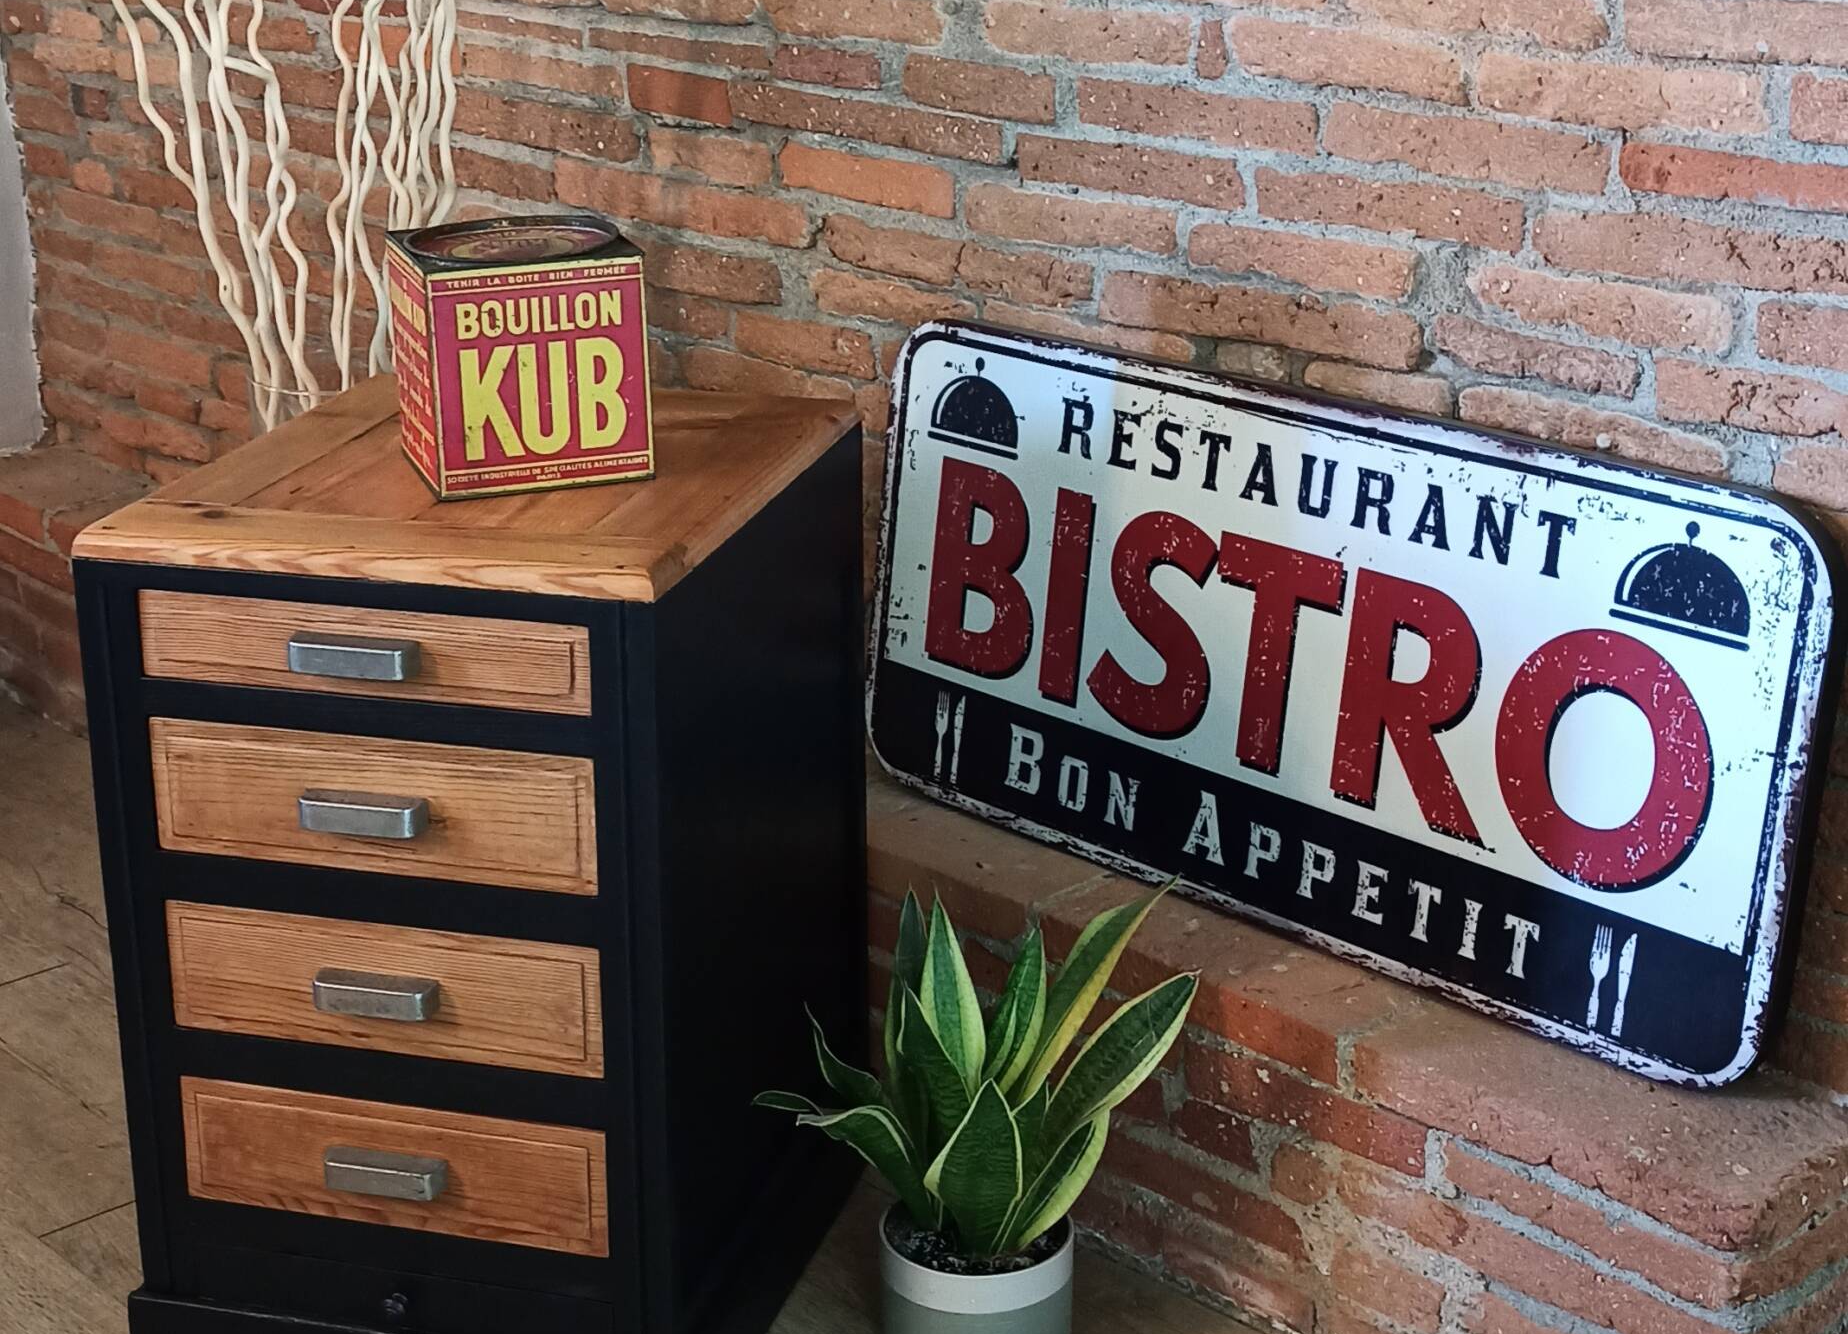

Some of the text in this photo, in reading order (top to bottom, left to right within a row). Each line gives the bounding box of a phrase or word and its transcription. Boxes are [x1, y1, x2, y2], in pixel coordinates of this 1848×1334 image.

[446, 280, 481, 289] TENIR
[487, 277, 501, 286] LA
[549, 271, 574, 281] BIEN
[455, 289, 622, 340] BOUILLON
[459, 336, 628, 462] KUB
[1057, 393, 1578, 579] RESTAURANT
[923, 455, 1715, 893] BISTRO
